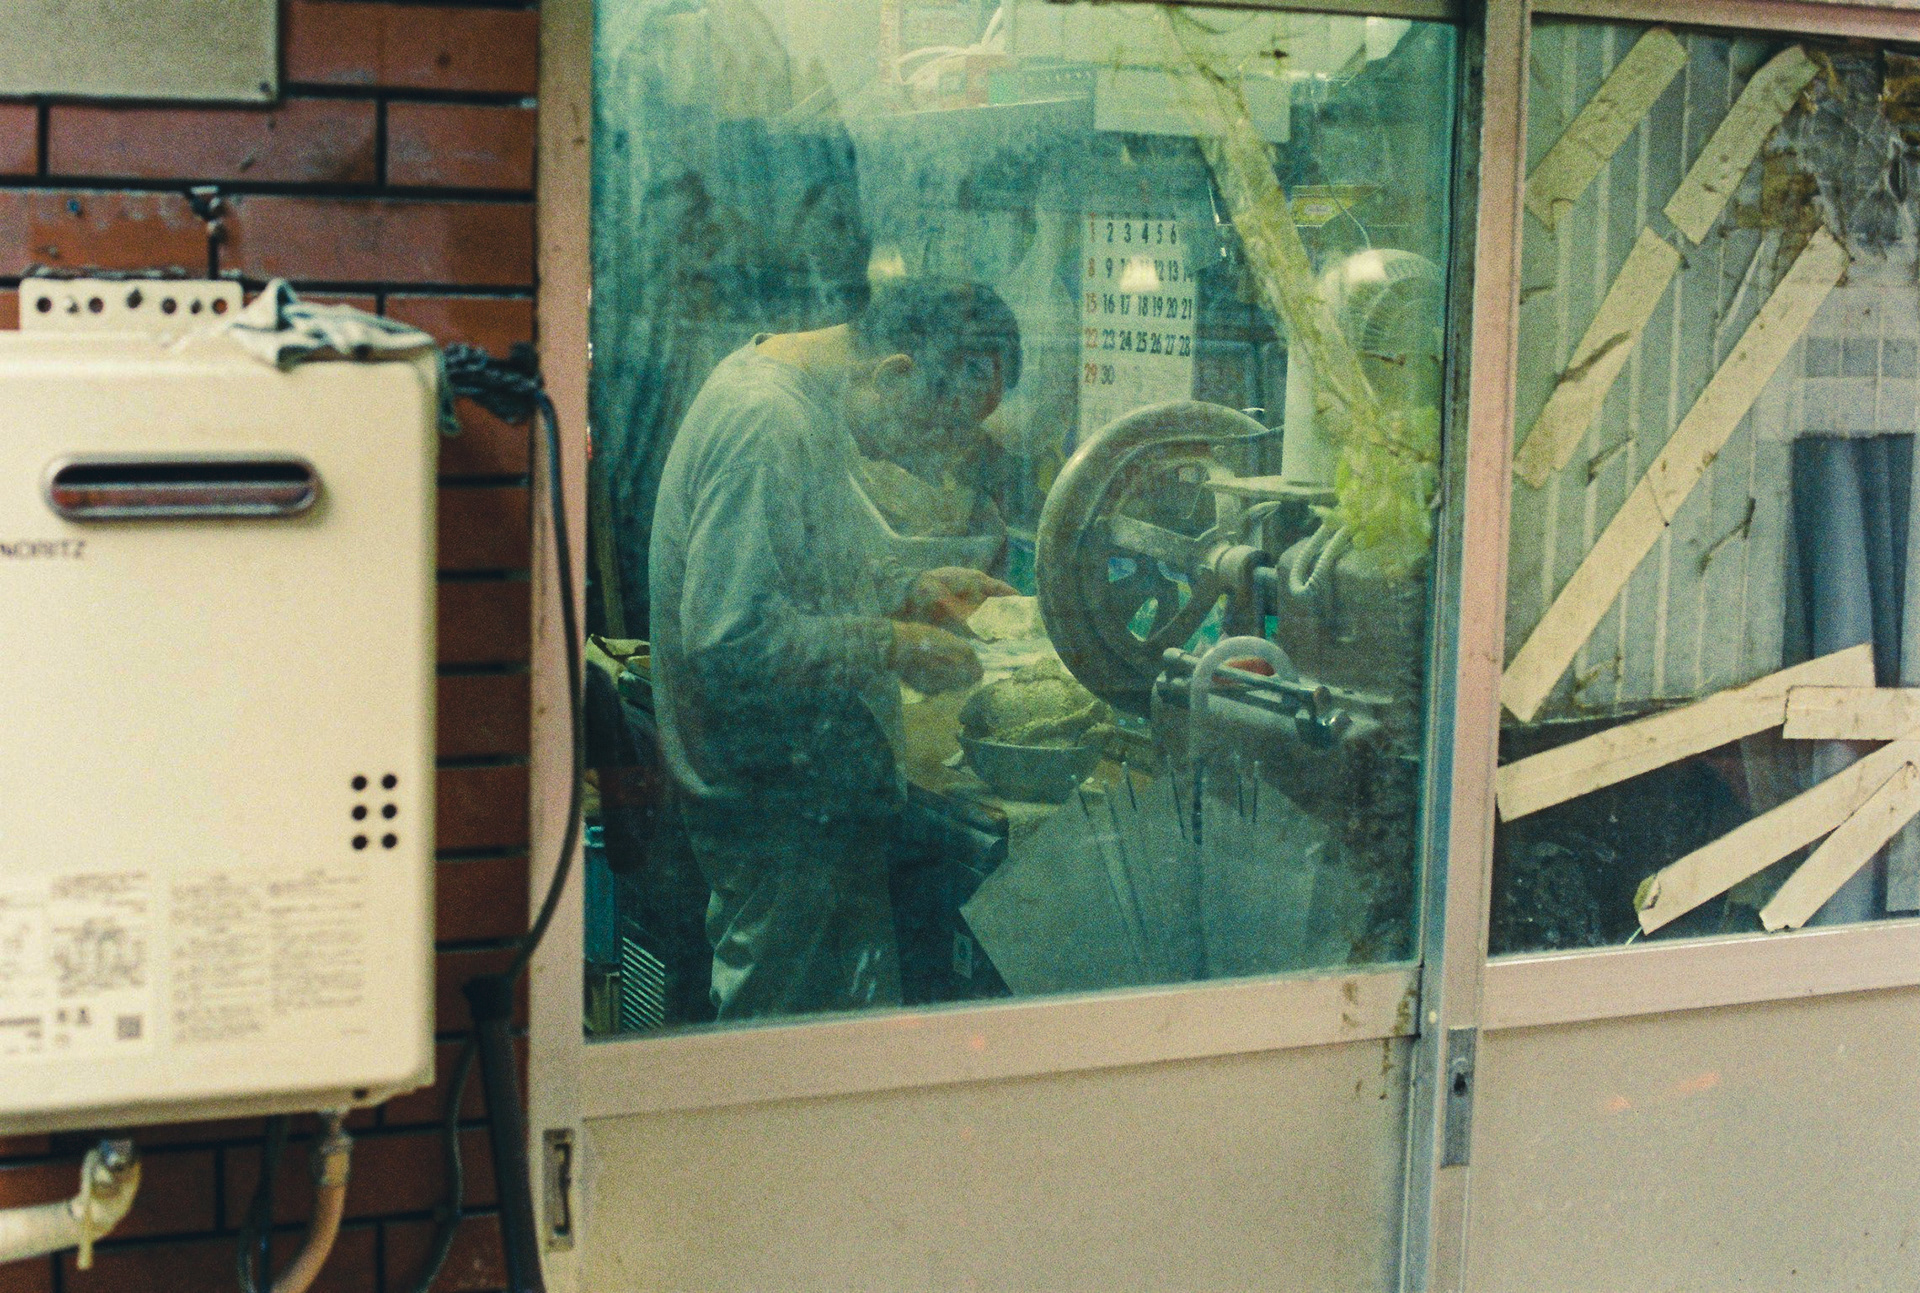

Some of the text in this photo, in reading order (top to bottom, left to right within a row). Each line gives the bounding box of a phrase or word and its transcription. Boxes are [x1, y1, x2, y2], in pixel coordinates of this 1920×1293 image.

[1106, 222, 1114, 243] 2
[1124, 222, 1132, 243] 3
[1142, 222, 1149, 244] 4
[1157, 223, 1163, 244] 5
[1170, 223, 1177, 244] 6
[1105, 257, 1113, 279] 9
[1168, 260, 1179, 281] 13
[1085, 292, 1192, 320] 15 16 17 18 19 20 21
[1084, 327, 1191, 357] 22 23 24 25 26 27 28
[1084, 362, 1115, 385] 29 30
